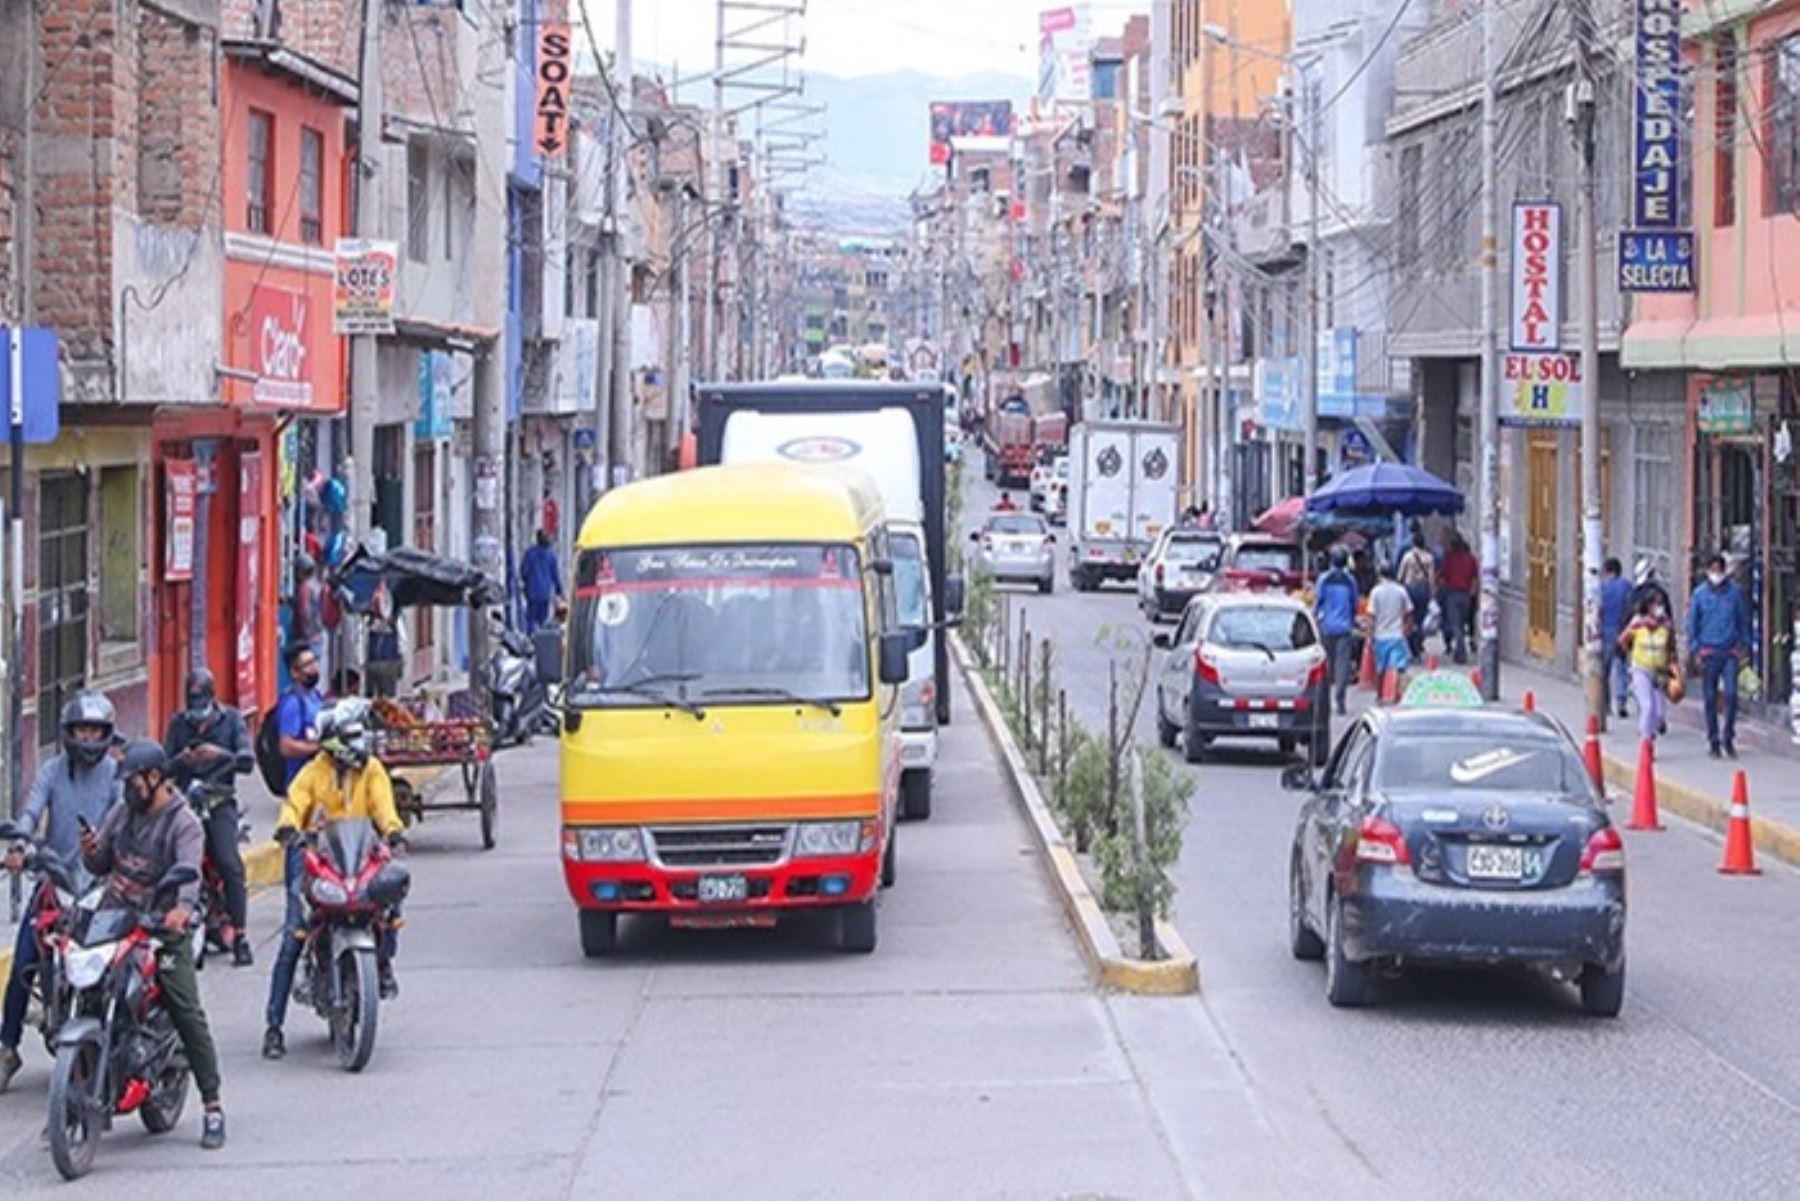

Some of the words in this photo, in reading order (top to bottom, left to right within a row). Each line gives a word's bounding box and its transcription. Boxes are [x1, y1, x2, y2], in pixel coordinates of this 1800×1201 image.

[538, 33, 568, 133] SOAT
[1645, 238, 1667, 260] LA
[338, 267, 390, 288] LOTES
[1522, 209, 1549, 344] HOSTAL
[1622, 263, 1690, 287] SELECTA
[261, 314, 303, 379] Claro
[1505, 356, 1533, 379] EL
[1539, 356, 1582, 383] SOL
[1531, 384, 1549, 409] H
